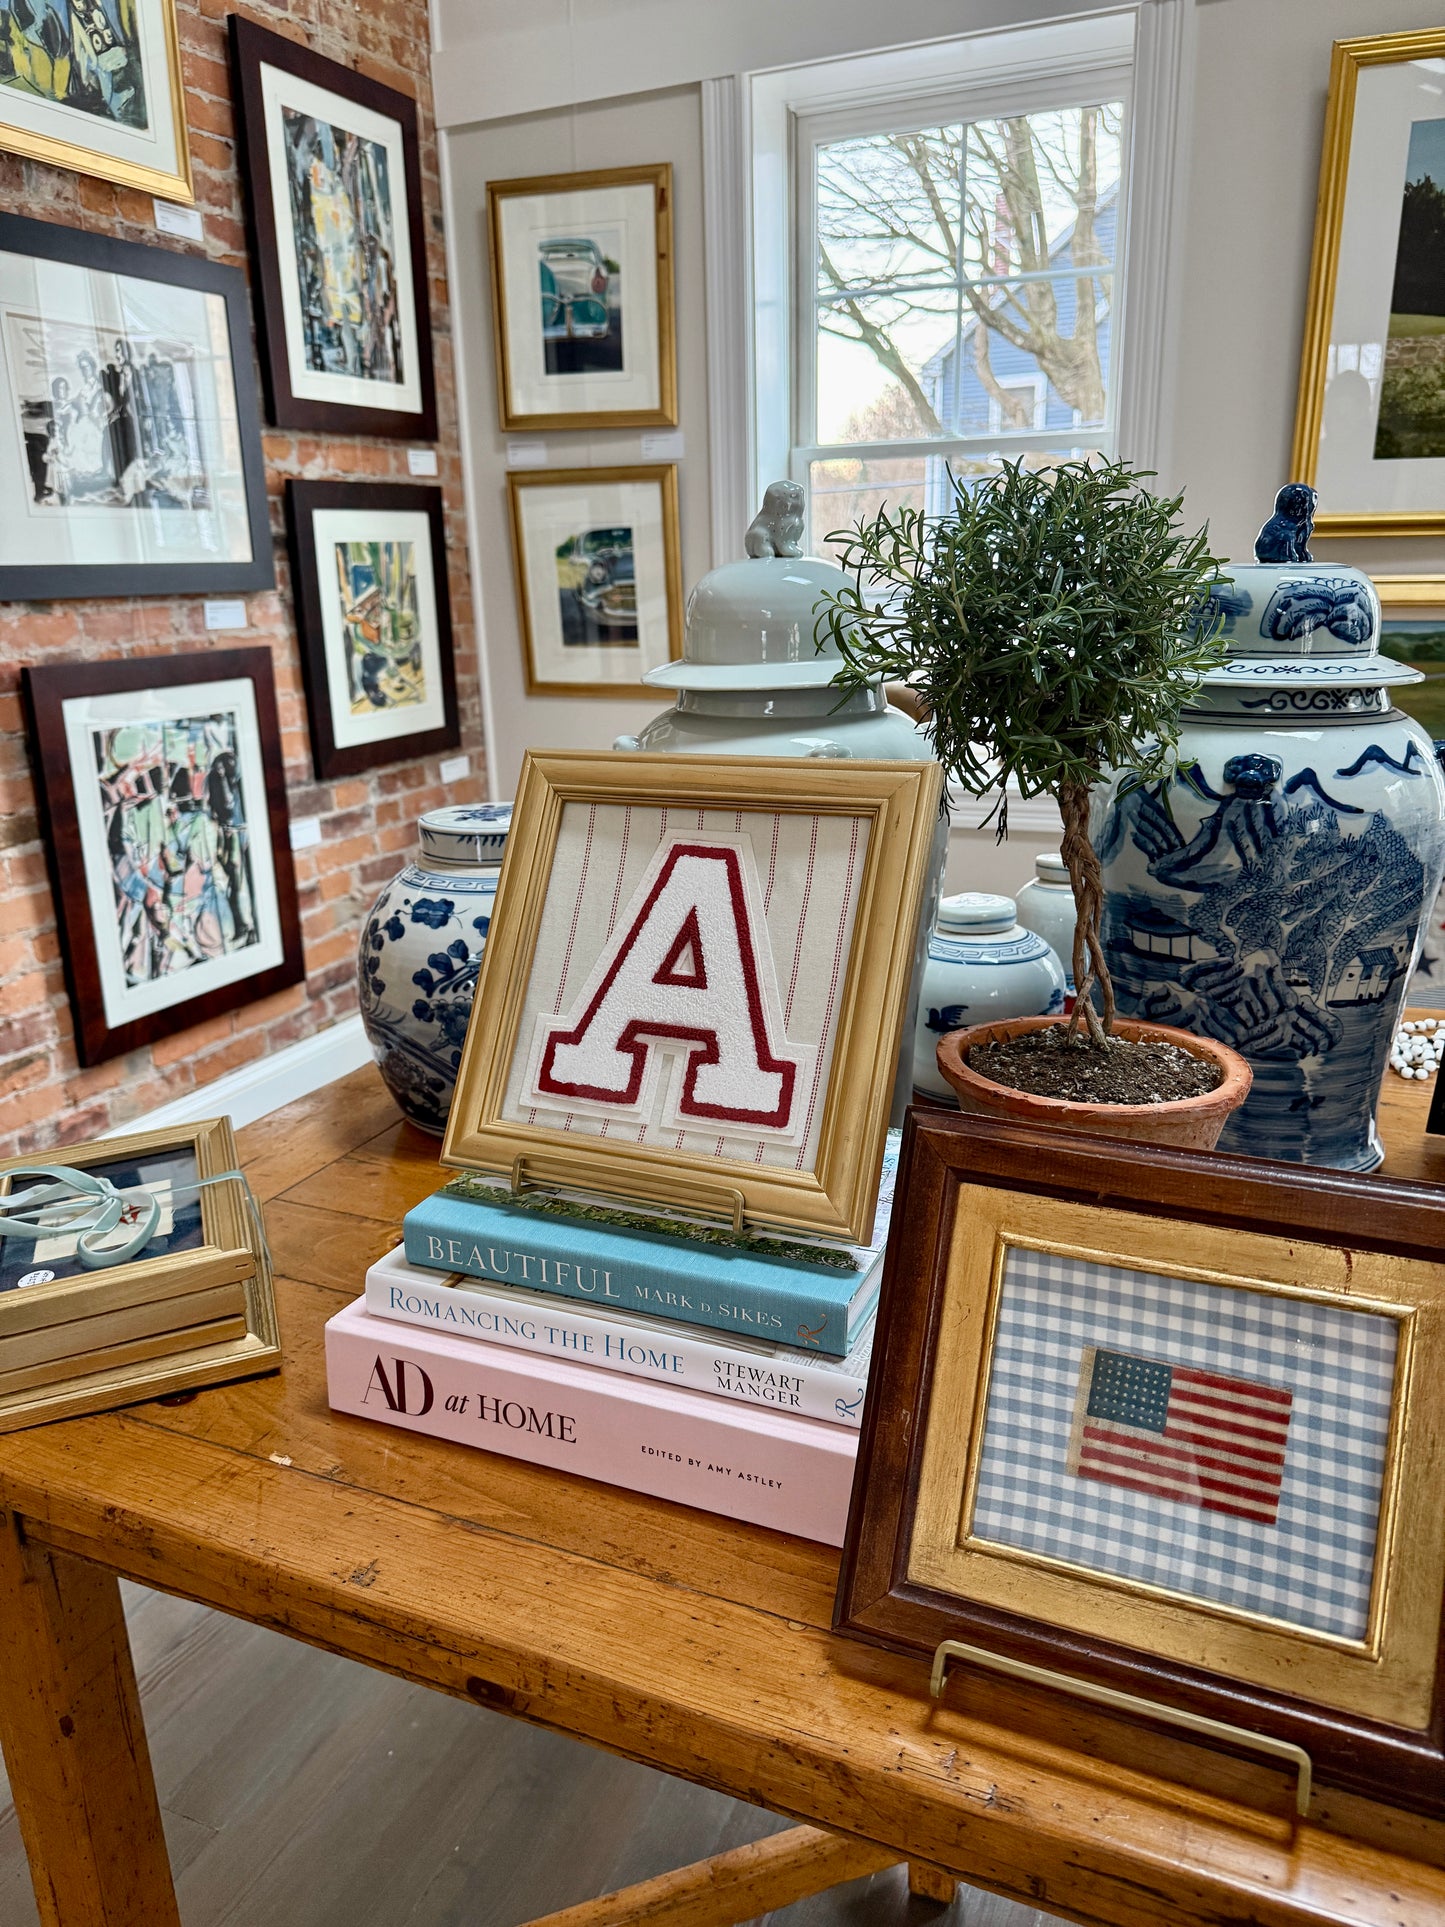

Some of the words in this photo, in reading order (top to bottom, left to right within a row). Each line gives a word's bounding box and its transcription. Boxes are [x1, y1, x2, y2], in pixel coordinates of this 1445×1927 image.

[538, 844, 796, 1128] A
[426, 1235, 620, 1298] BEAUTIFUL
[634, 1285, 694, 1309] MARK
[701, 1302, 713, 1314] D.
[719, 1303, 783, 1328] SIKES
[389, 1286, 536, 1340] ROMANCING
[544, 1325, 594, 1354] THE
[604, 1334, 684, 1374] HOME
[797, 1313, 828, 1345] R
[713, 1359, 805, 1392] STEWART
[717, 1376, 802, 1408] MANGER
[360, 1354, 434, 1417] AD
[444, 1394, 470, 1414] at
[477, 1393, 577, 1443] HOME
[834, 1388, 864, 1418] R
[641, 1445, 682, 1463] EDITED
[688, 1458, 701, 1468] BY
[707, 1464, 732, 1476] AMY
[738, 1472, 782, 1489] ASTLEY
